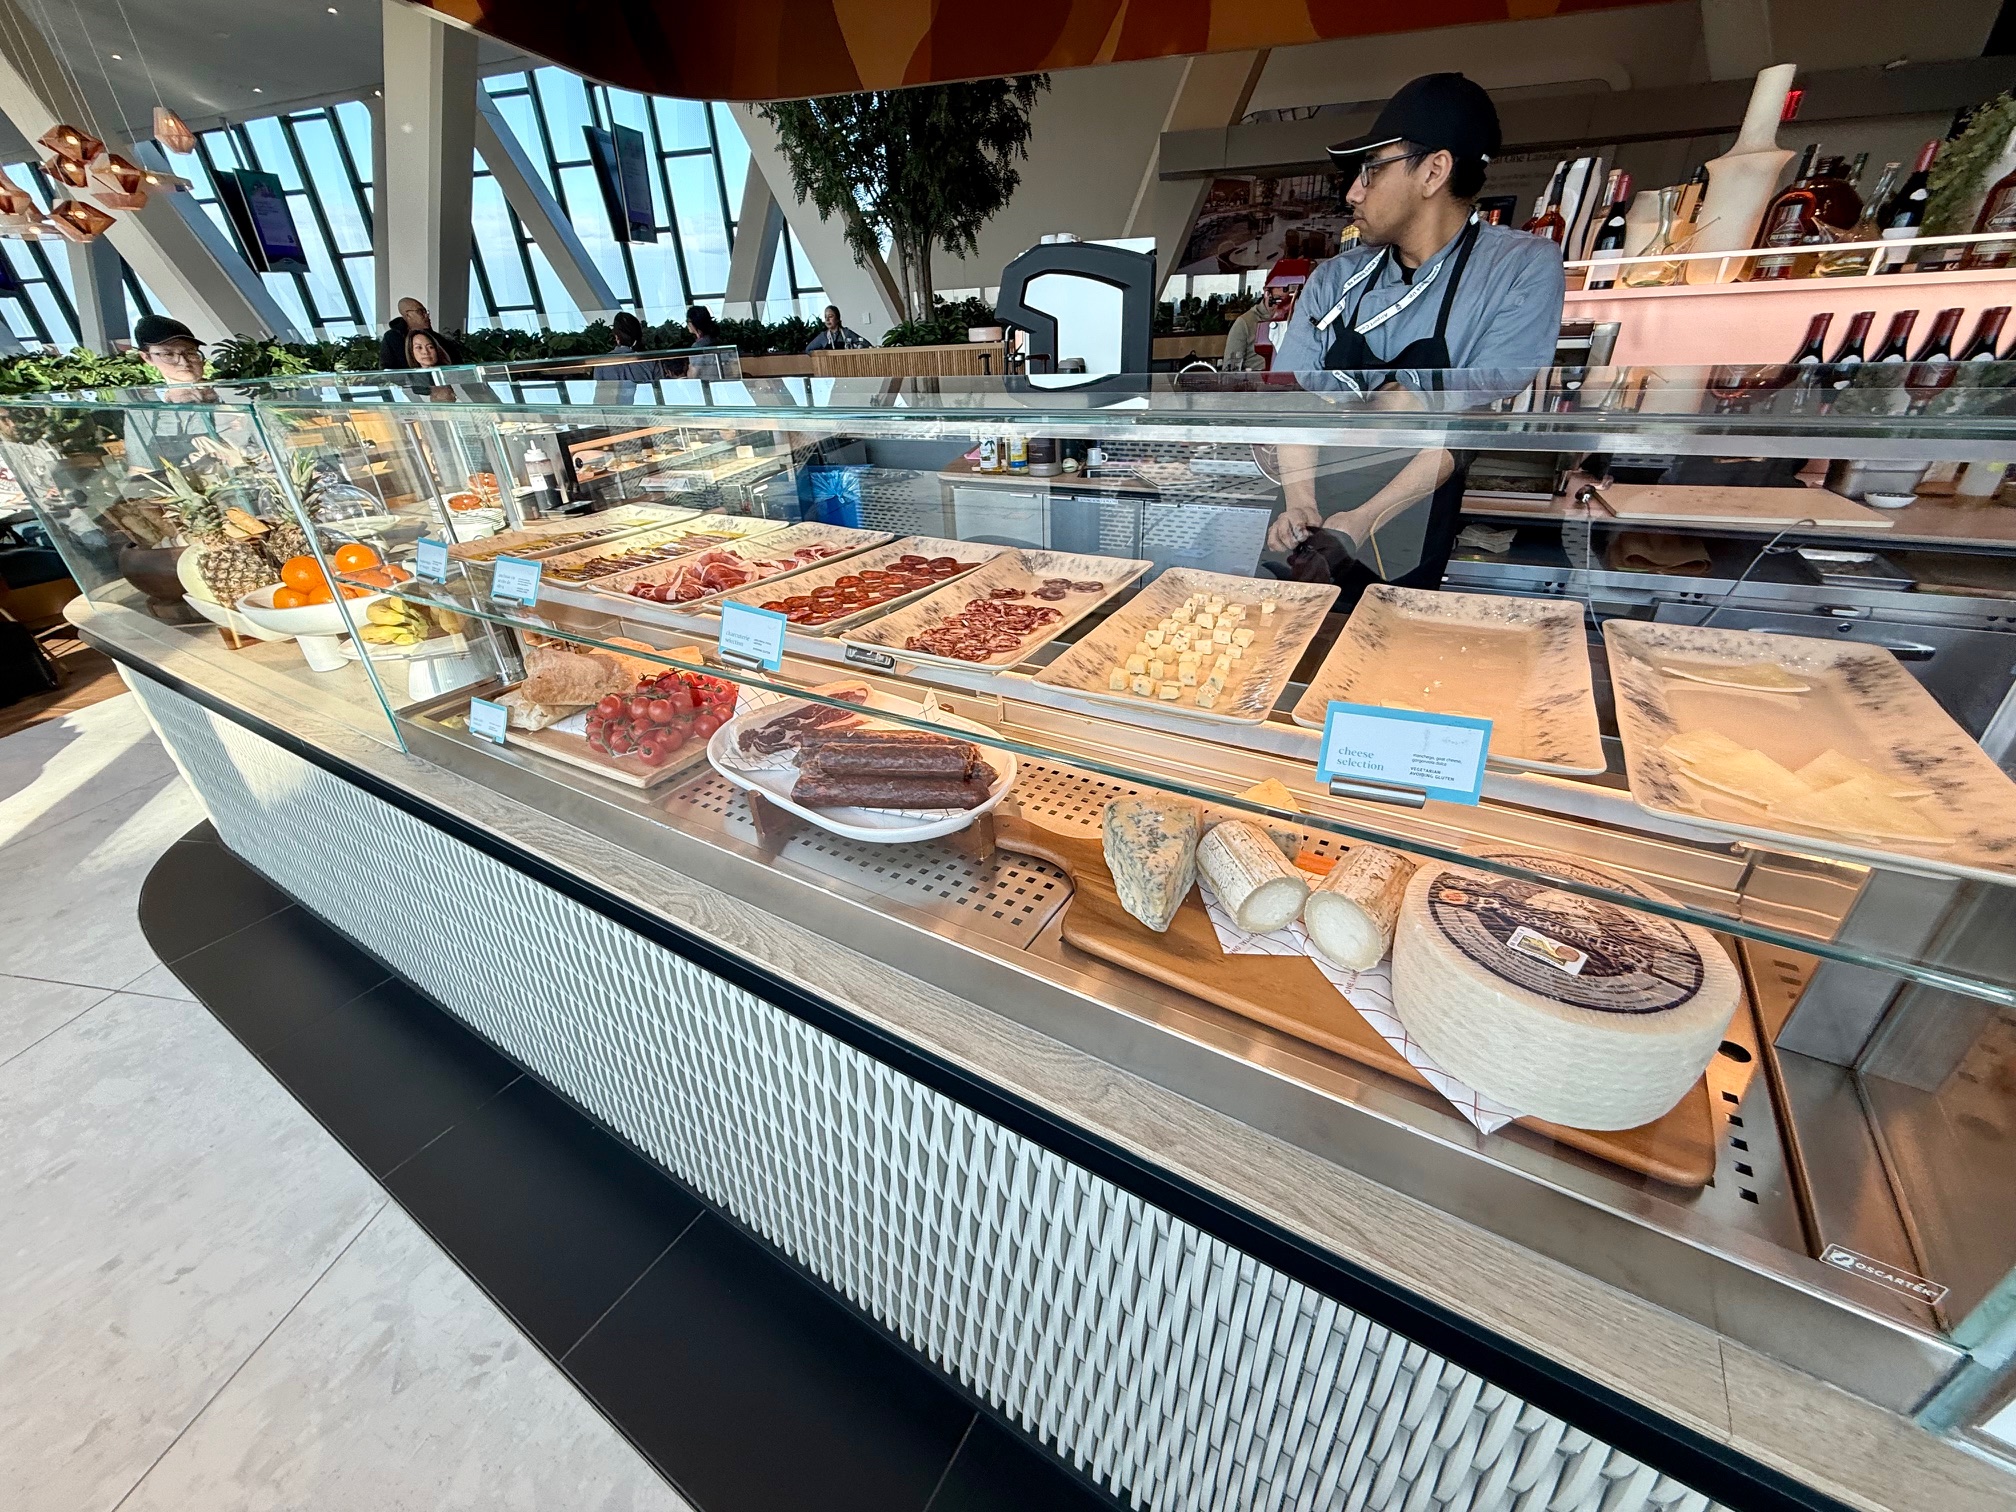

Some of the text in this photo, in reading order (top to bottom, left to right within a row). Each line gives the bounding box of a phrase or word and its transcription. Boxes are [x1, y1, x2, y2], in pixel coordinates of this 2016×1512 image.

[1338, 746, 1375, 759] cheese
[1336, 758, 1385, 772] selection
[1410, 766, 1441, 774] VEGETARIAN
[1409, 771, 1434, 780] AVOIDING
